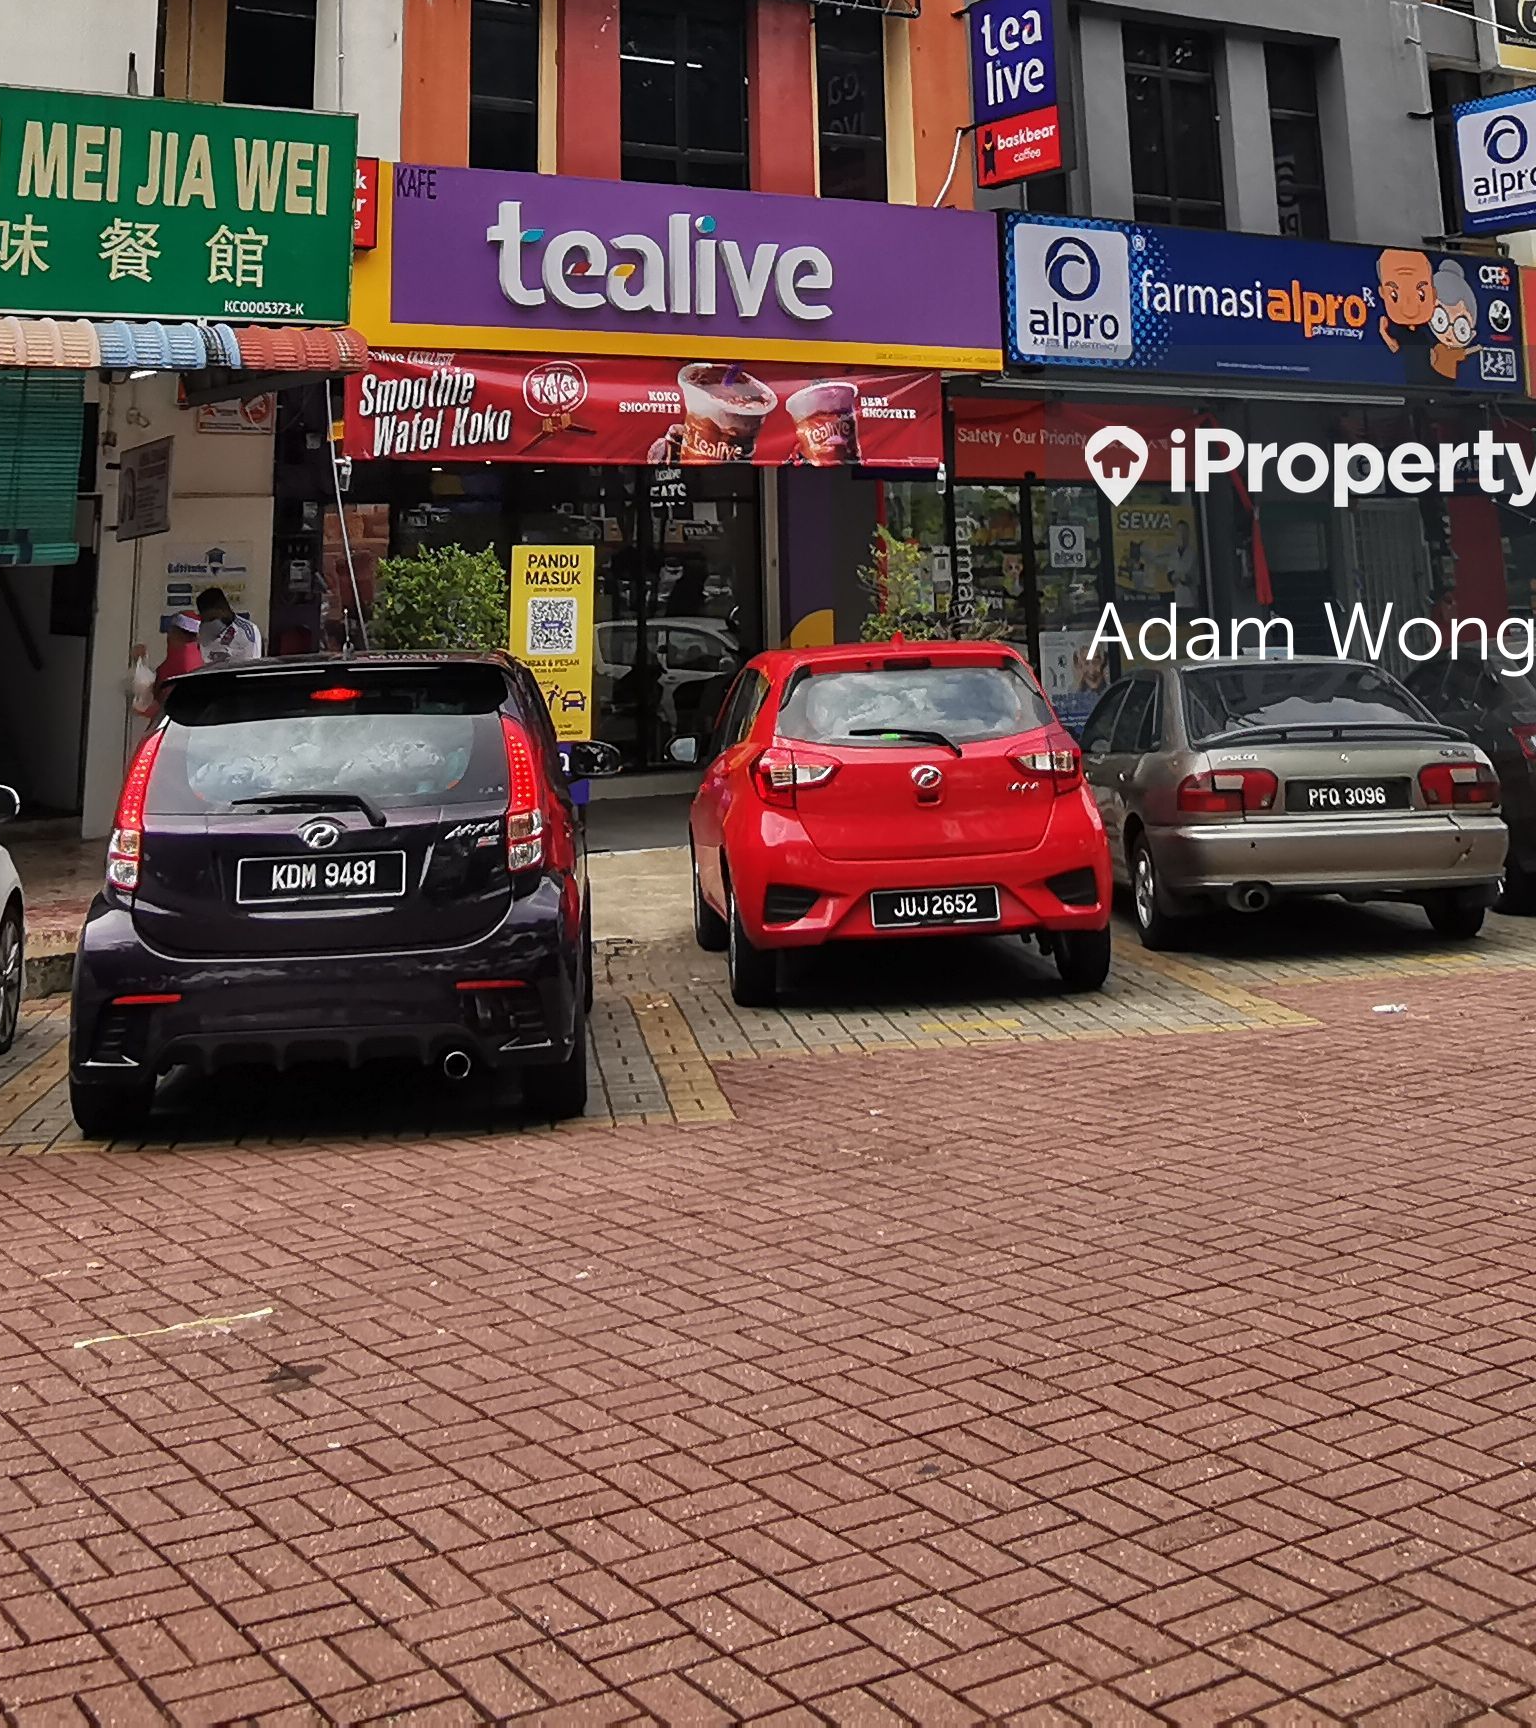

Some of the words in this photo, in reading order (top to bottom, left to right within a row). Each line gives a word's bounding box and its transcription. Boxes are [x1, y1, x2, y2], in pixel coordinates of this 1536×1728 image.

[981, 9, 1042, 57] tea
[986, 58, 1044, 106] live
[997, 124, 1056, 150] baskbear
[1013, 147, 1041, 163] coffee
[16, 121, 122, 203] MEI
[137, 131, 217, 209] JIA
[234, 137, 330, 216] WEI
[396, 167, 437, 200] KAFE
[486, 200, 834, 320] tealive
[223, 300, 305, 318] KC0005373-K
[1139, 270, 1262, 320] farmasi
[1267, 279, 1367, 338] alpro
[1029, 302, 1120, 349] alpro
[1311, 324, 1364, 339] pharmacy
[359, 366, 475, 416] Smoothie
[532, 372, 579, 404] KitKat
[648, 391, 680, 403] KOKO
[619, 402, 681, 414] SMOOTHIE
[373, 409, 443, 457] Wafel
[451, 404, 512, 448] Koko
[958, 428, 1001, 447] Safety
[1013, 428, 1036, 445] Our
[1120, 512, 1172, 530] SEWA
[528, 554, 579, 569] PANDU
[526, 571, 581, 586] MASUK
[1345, 786, 1385, 805] 3096
[272, 862, 317, 890] KDM
[324, 859, 376, 886] 9481
[893, 895, 929, 918] JUJ
[931, 892, 978, 914] 2652
